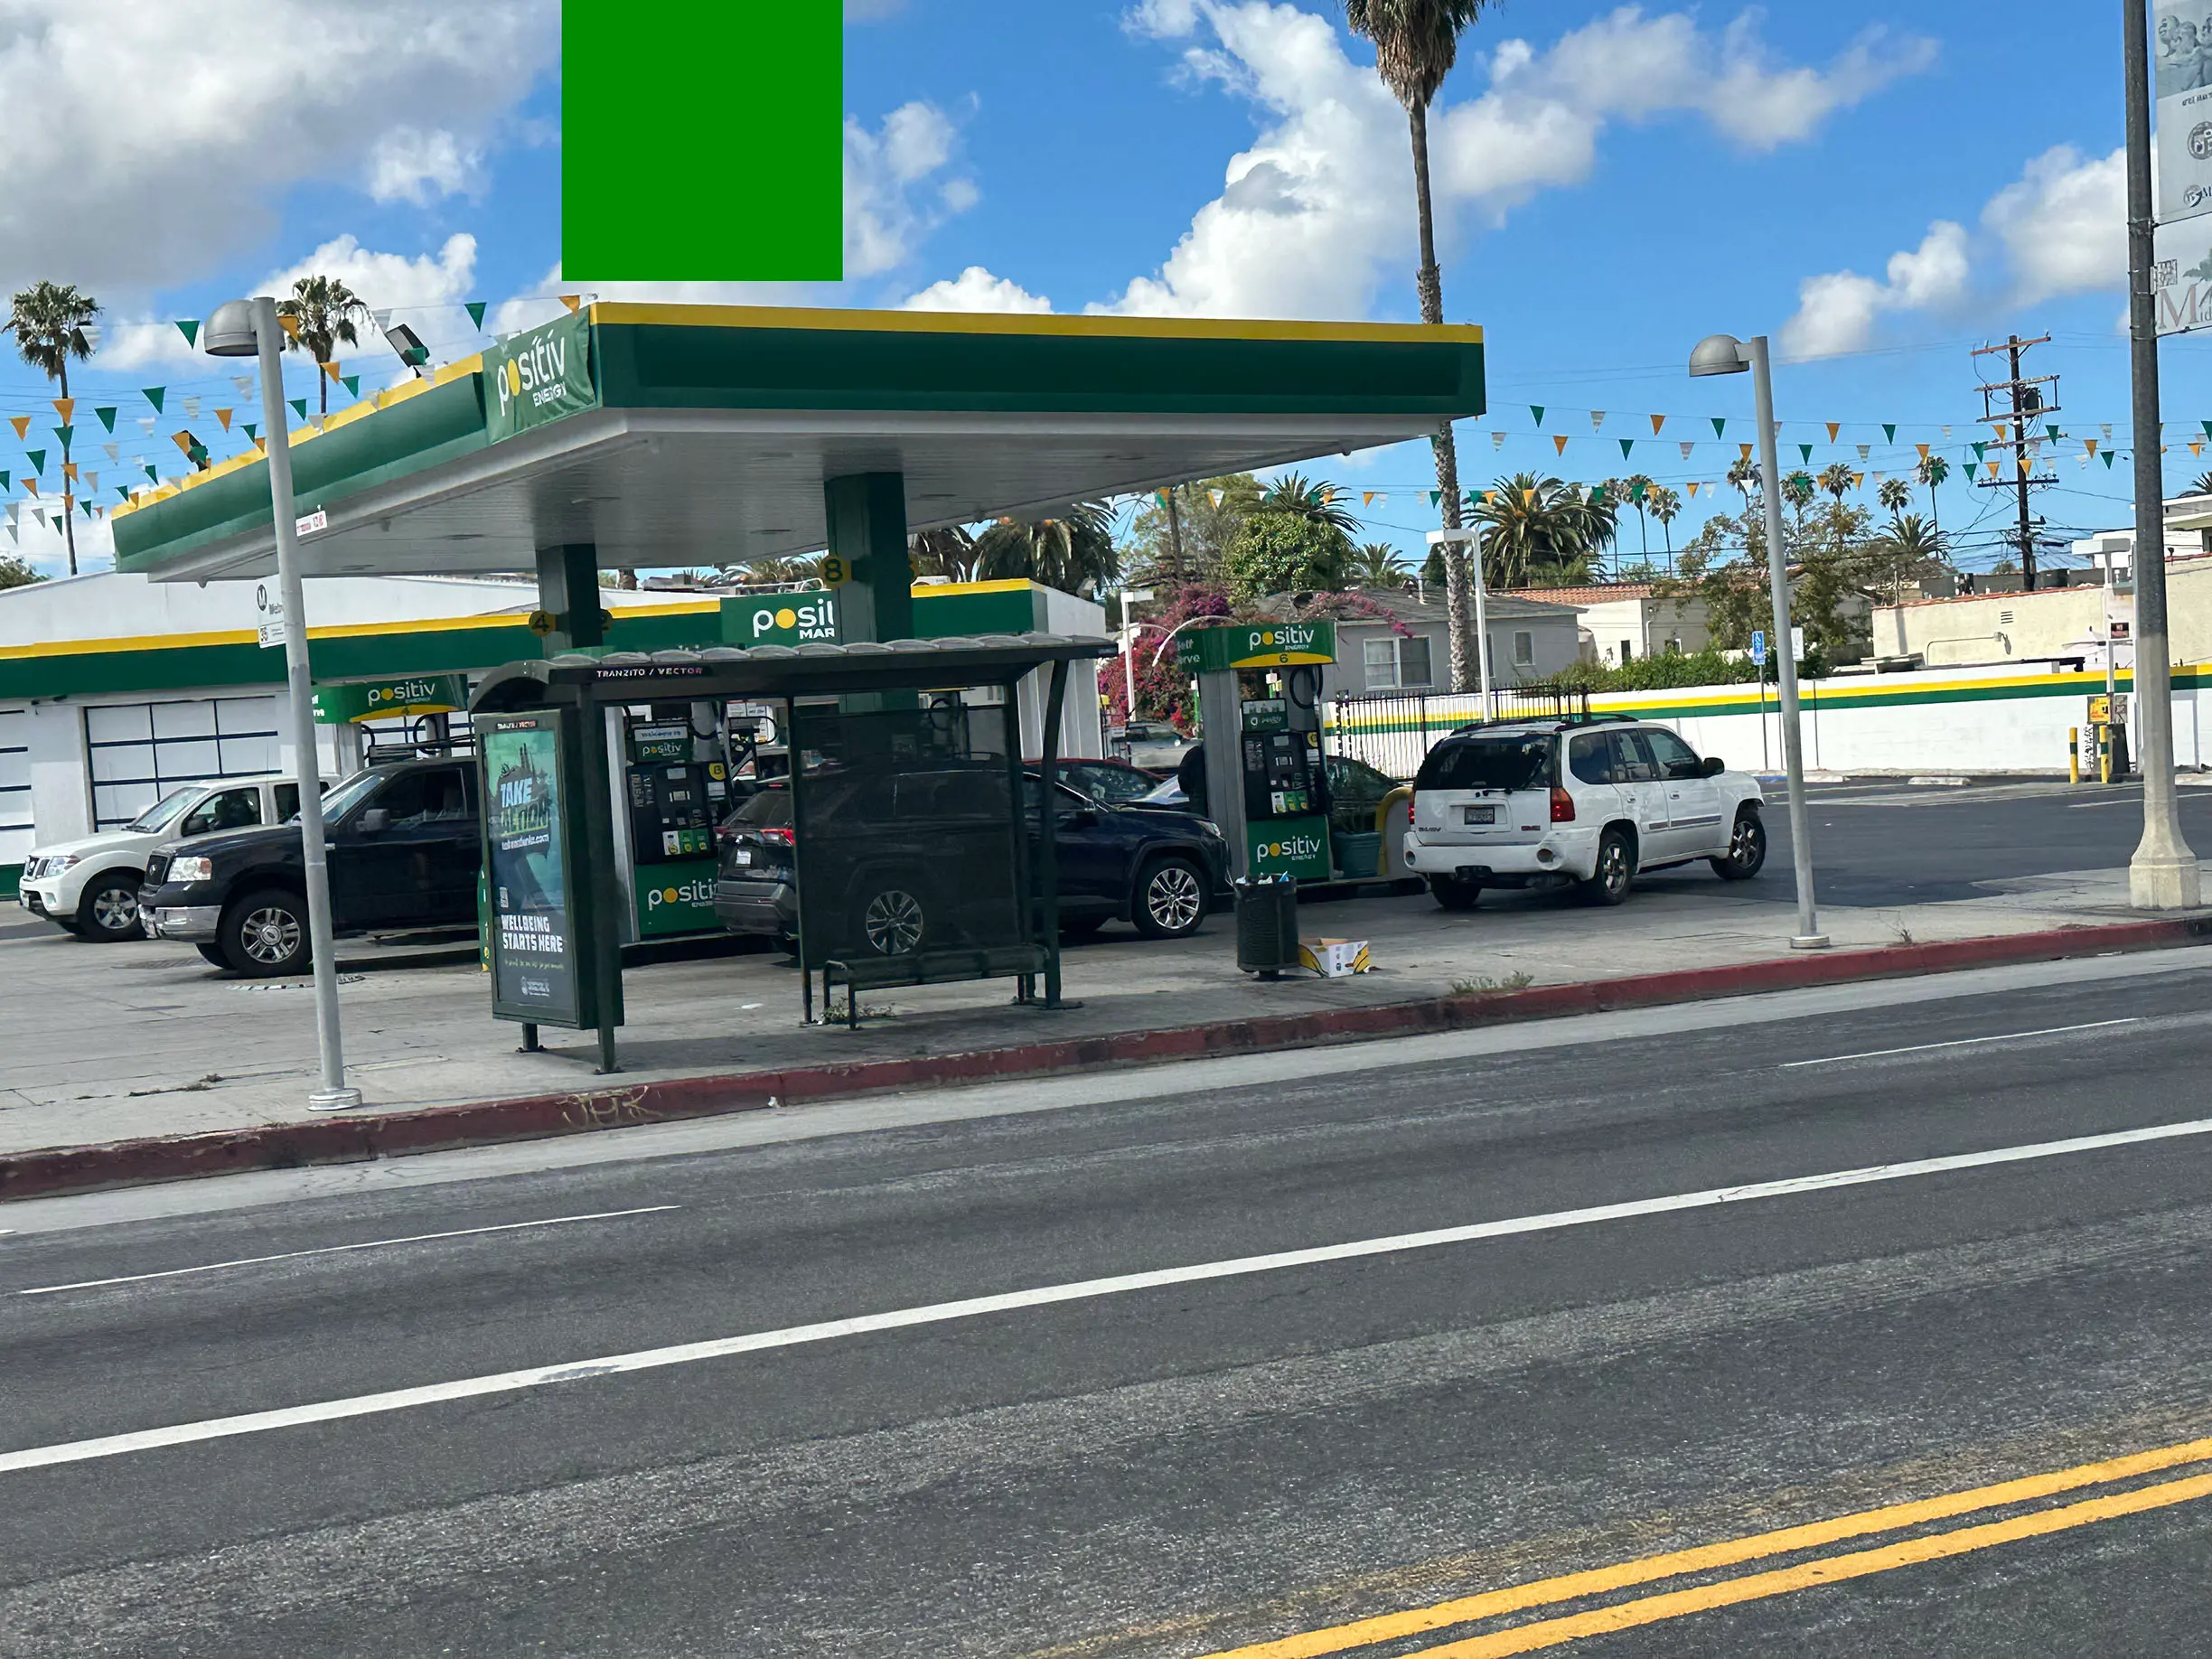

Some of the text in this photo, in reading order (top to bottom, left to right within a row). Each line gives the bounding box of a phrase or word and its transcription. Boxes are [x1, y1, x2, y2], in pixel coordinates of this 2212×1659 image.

[532, 381, 567, 407] ENERGY
[824, 558, 843, 582] 8
[531, 614, 549, 632] 4
[799, 628, 835, 640] MAR
[1250, 625, 1315, 651] positiv
[1279, 653, 1289, 663] 6
[597, 670, 645, 678] TRANZITO
[368, 680, 436, 707] positiv
[643, 742, 682, 756] positiv
[501, 778, 532, 808] TAKE
[1257, 836, 1320, 863] positiv
[501, 914, 550, 932] WELLBEING
[502, 933, 564, 953] STARTS HERE
